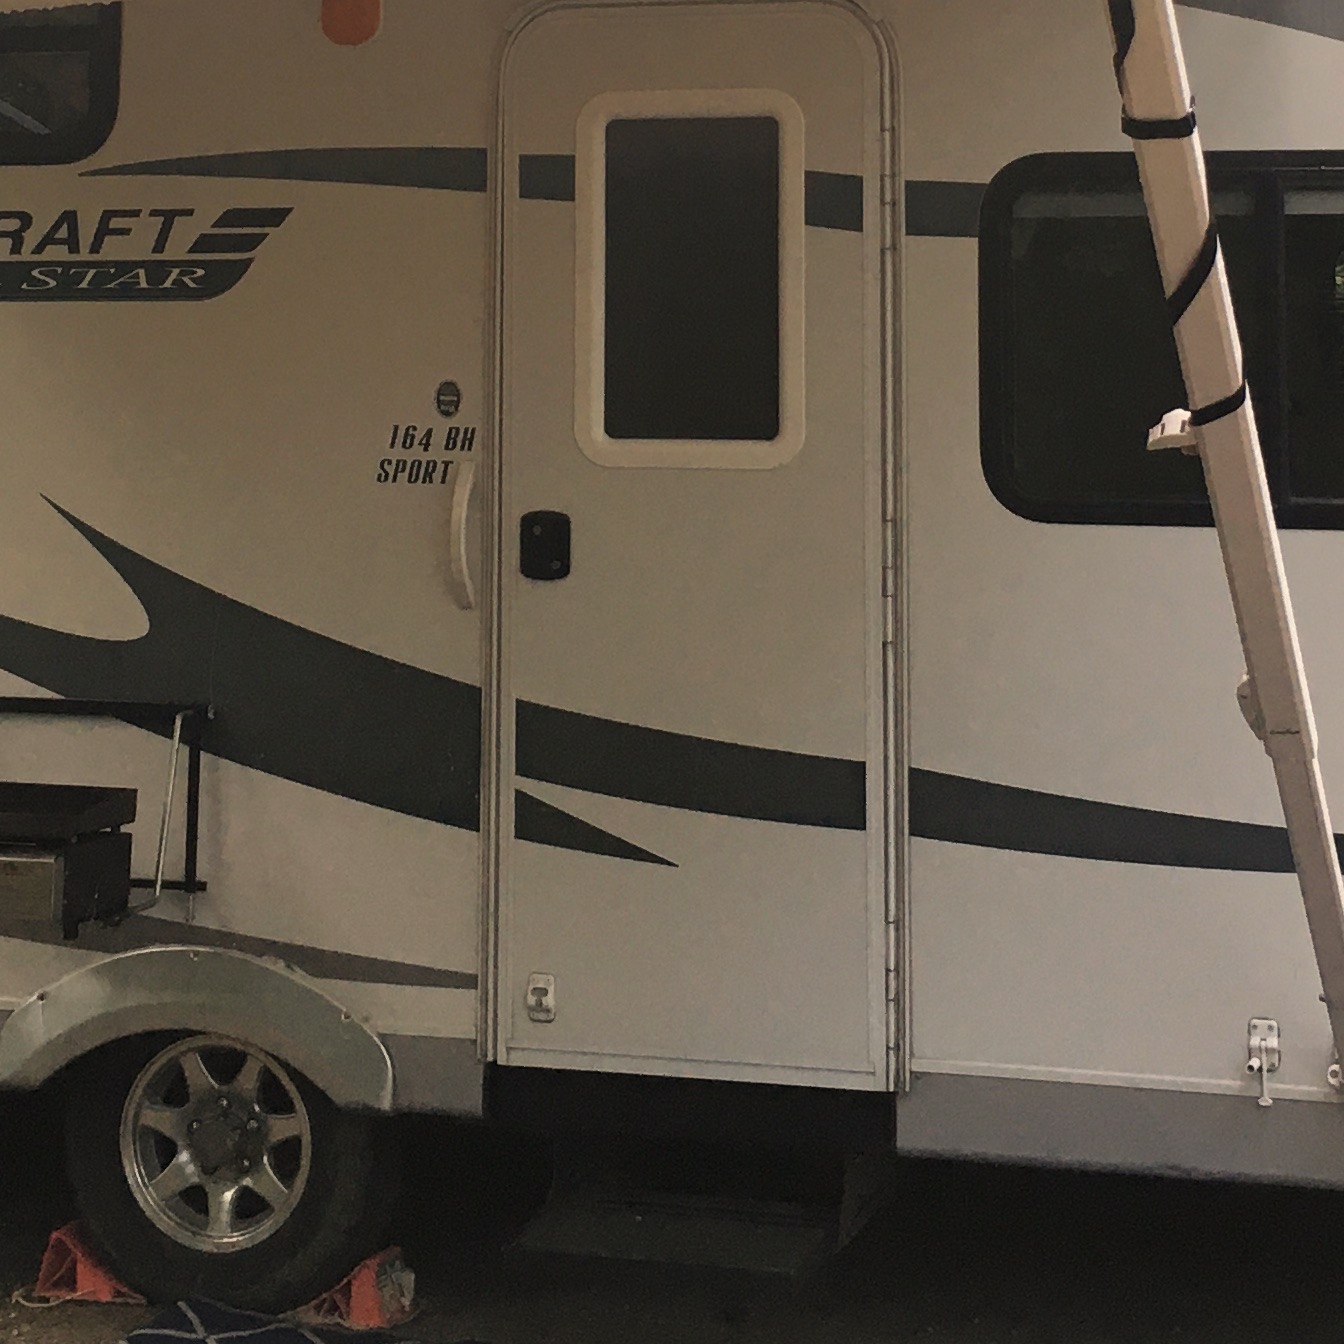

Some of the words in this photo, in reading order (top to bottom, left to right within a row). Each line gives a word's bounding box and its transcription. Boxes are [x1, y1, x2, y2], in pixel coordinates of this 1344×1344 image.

[21, 265, 207, 291] STAR
[388, 424, 434, 453] 164
[443, 426, 477, 452] BH
[376, 458, 455, 485] SPORT
